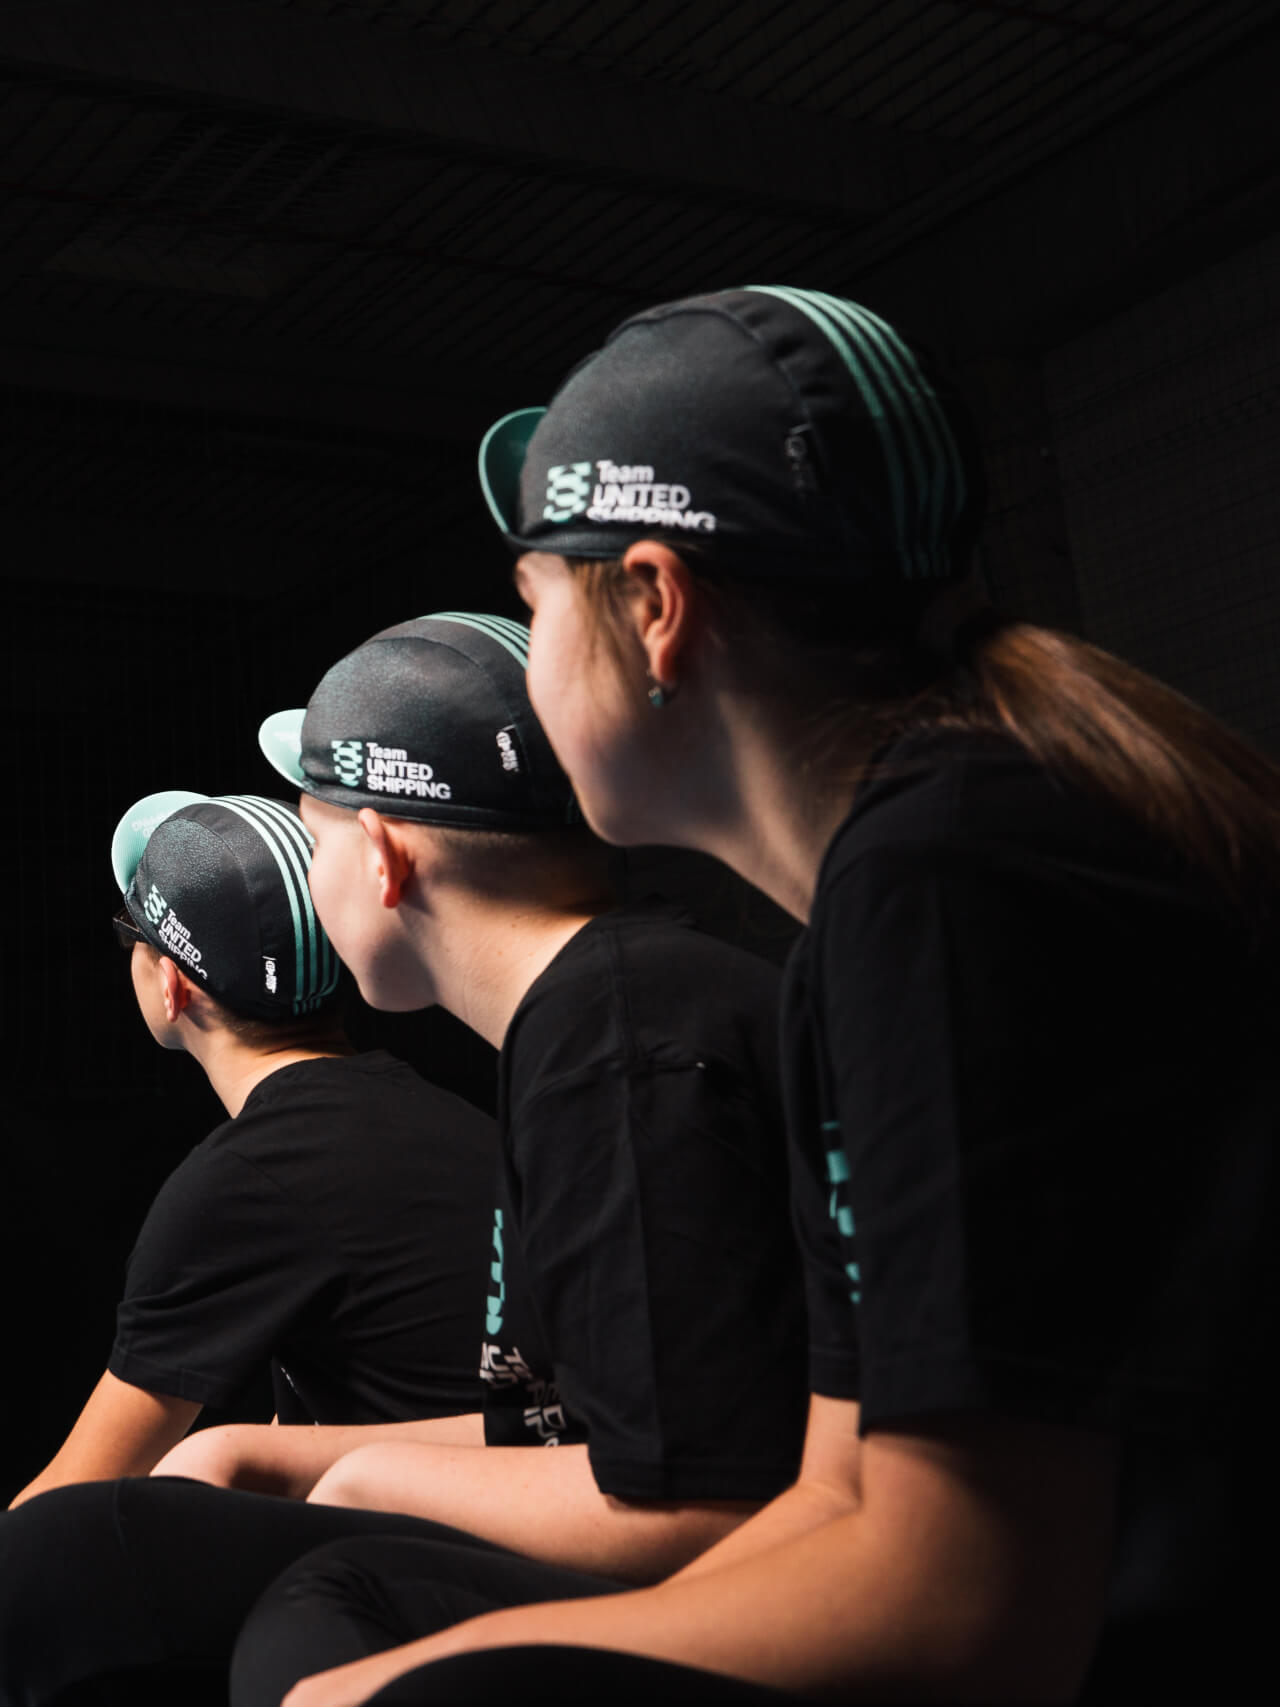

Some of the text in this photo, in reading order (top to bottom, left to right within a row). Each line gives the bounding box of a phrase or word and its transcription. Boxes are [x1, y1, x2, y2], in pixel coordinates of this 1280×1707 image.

[596, 460, 654, 484] Team
[593, 483, 691, 510] UNITED
[366, 742, 408, 761] Team
[366, 758, 433, 781] UNITED
[366, 774, 451, 800] SHIPPING
[167, 908, 192, 940] Team
[160, 918, 202, 963] UNITED
